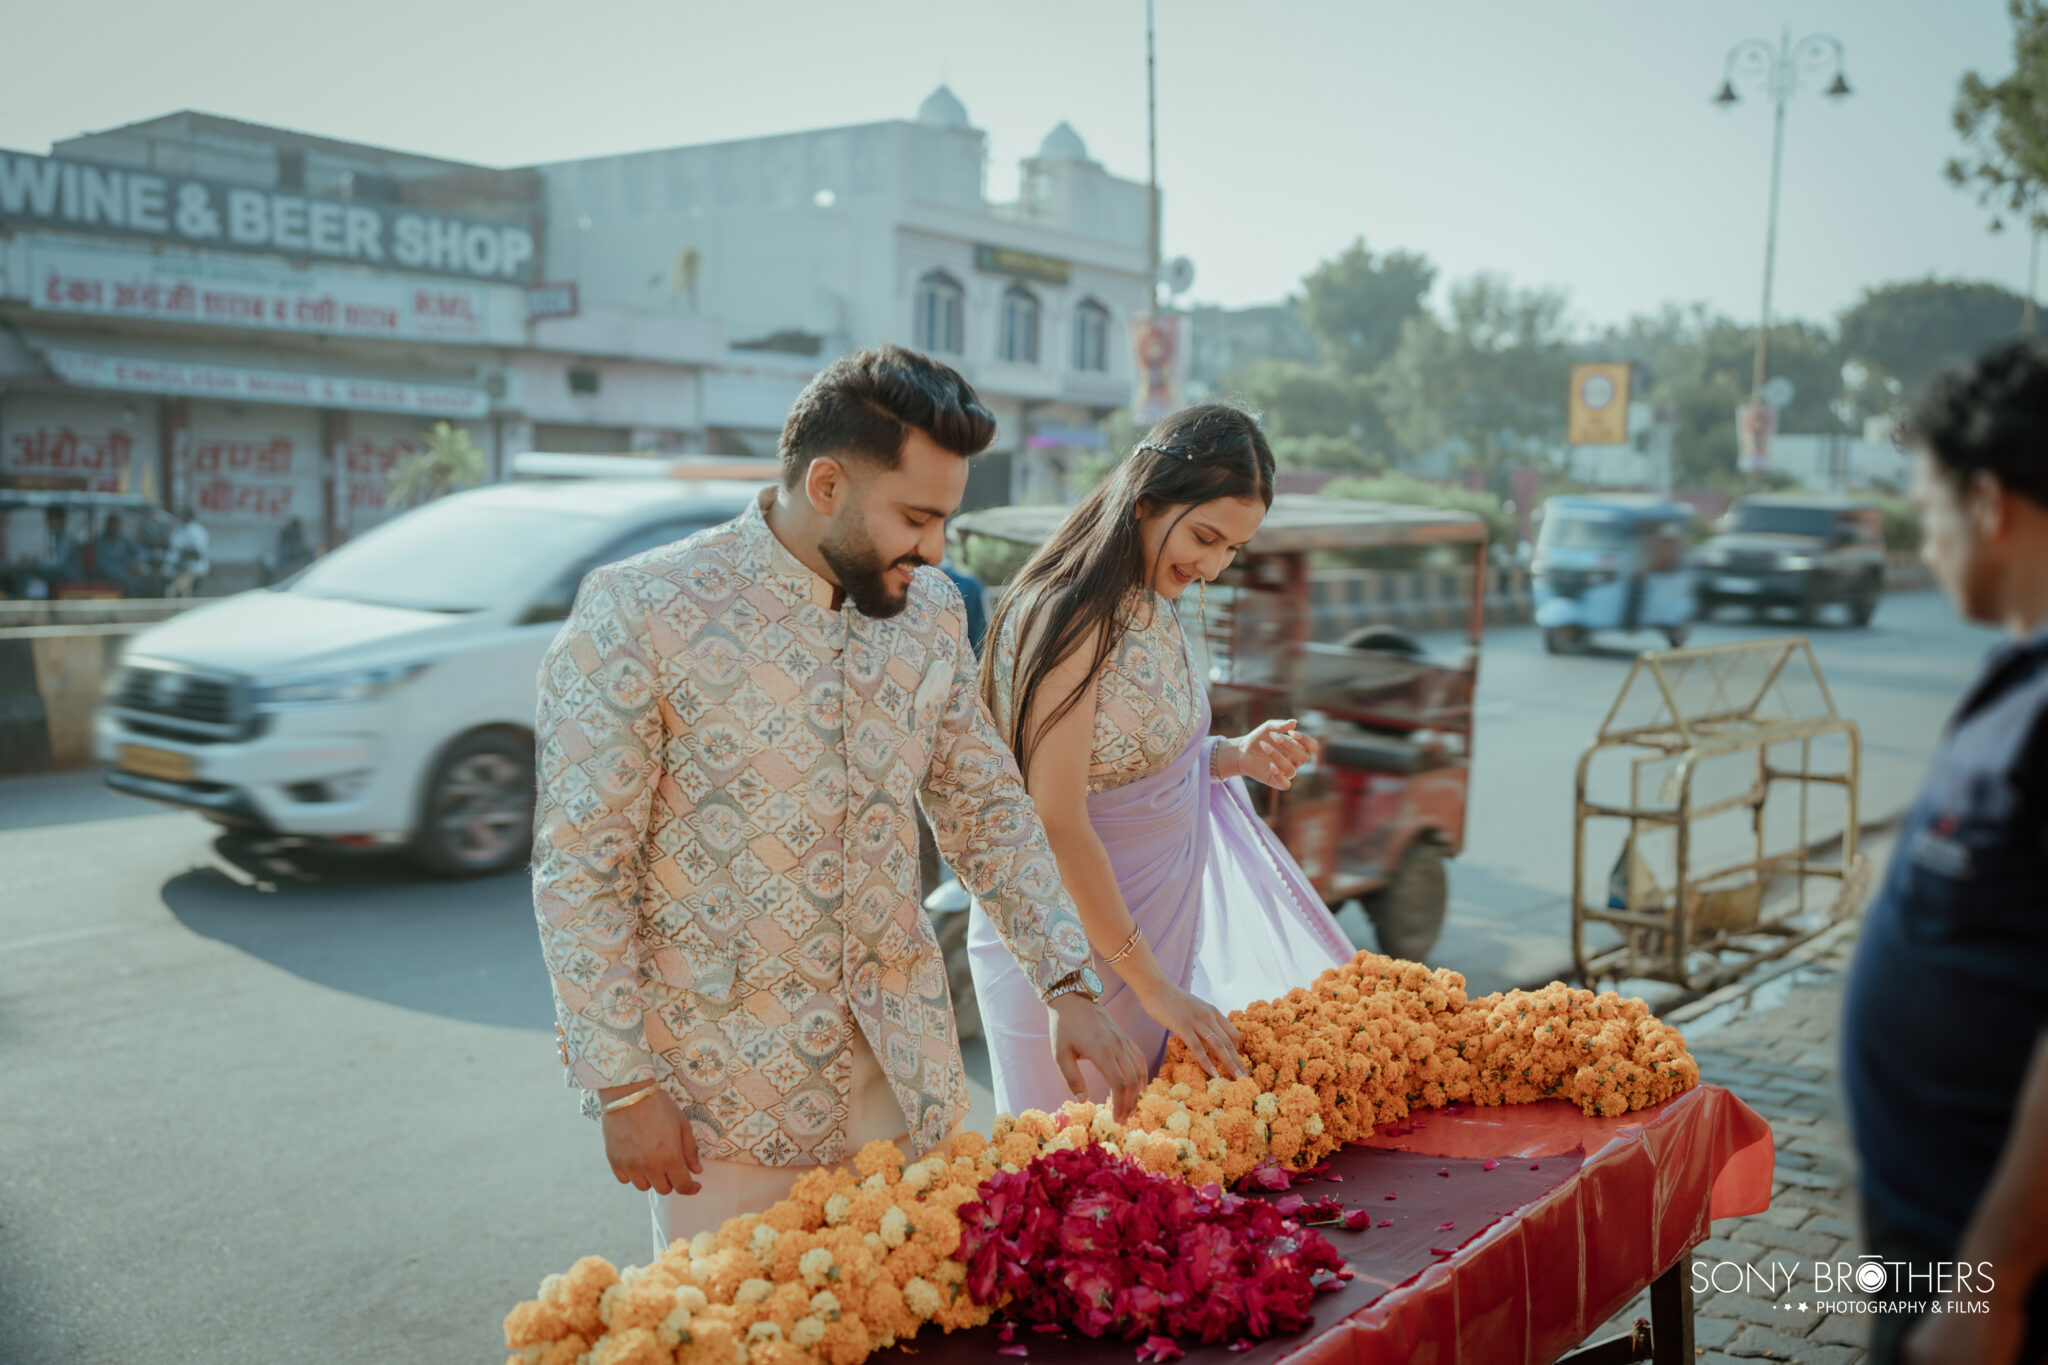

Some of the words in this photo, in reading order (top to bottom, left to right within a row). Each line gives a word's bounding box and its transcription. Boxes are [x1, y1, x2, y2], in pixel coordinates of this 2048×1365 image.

[0, 154, 168, 233] WINE
[175, 182, 220, 238] &
[229, 188, 383, 260] BEER
[392, 214, 533, 276] SHOP
